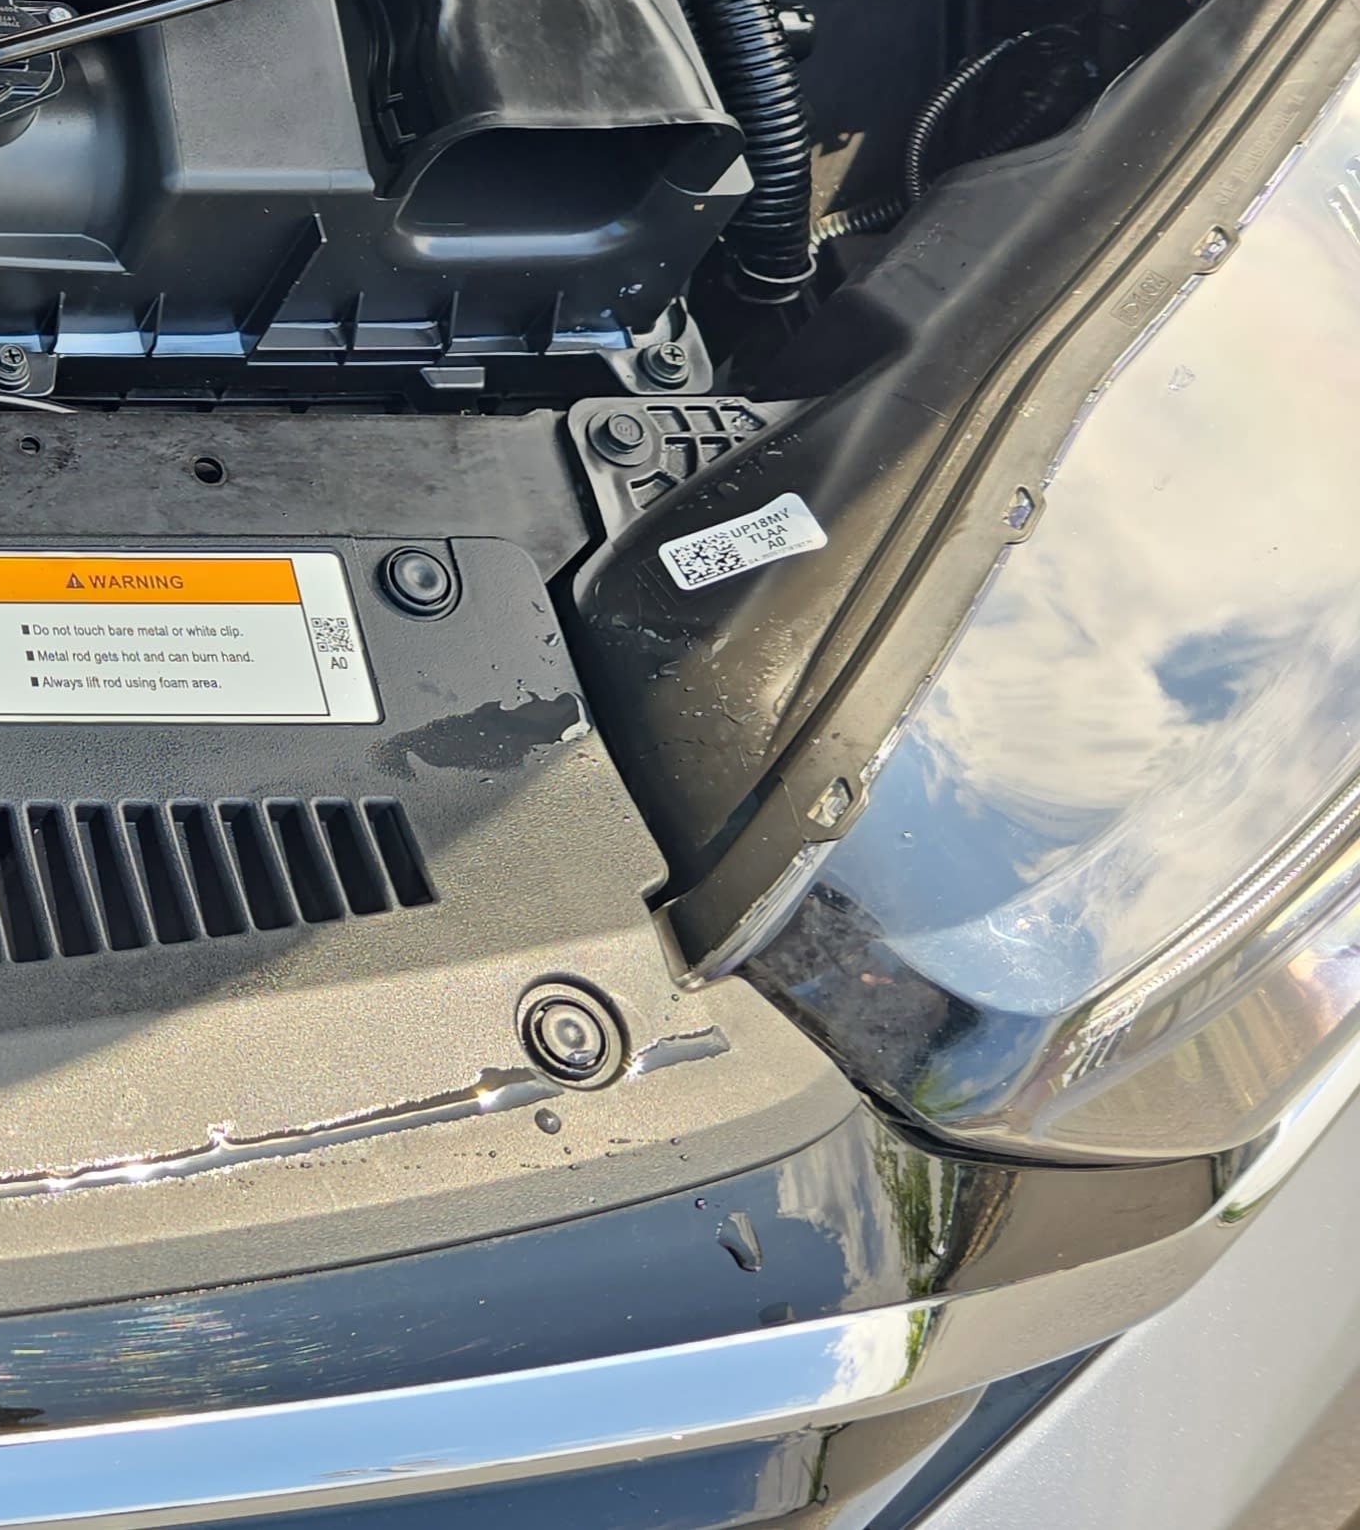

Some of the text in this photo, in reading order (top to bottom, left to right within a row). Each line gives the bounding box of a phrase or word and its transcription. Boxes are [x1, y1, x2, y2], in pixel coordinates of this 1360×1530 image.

[730, 507, 790, 539] UP18MY
[749, 524, 789, 545] TLAA
[88, 574, 184, 589] WARNING
[32, 624, 244, 639] Do not touch bare metal or white clip.
[37, 650, 255, 665] Metal rod gets hot and can burn hand.
[42, 676, 222, 691] Always lift rod using foam area.
